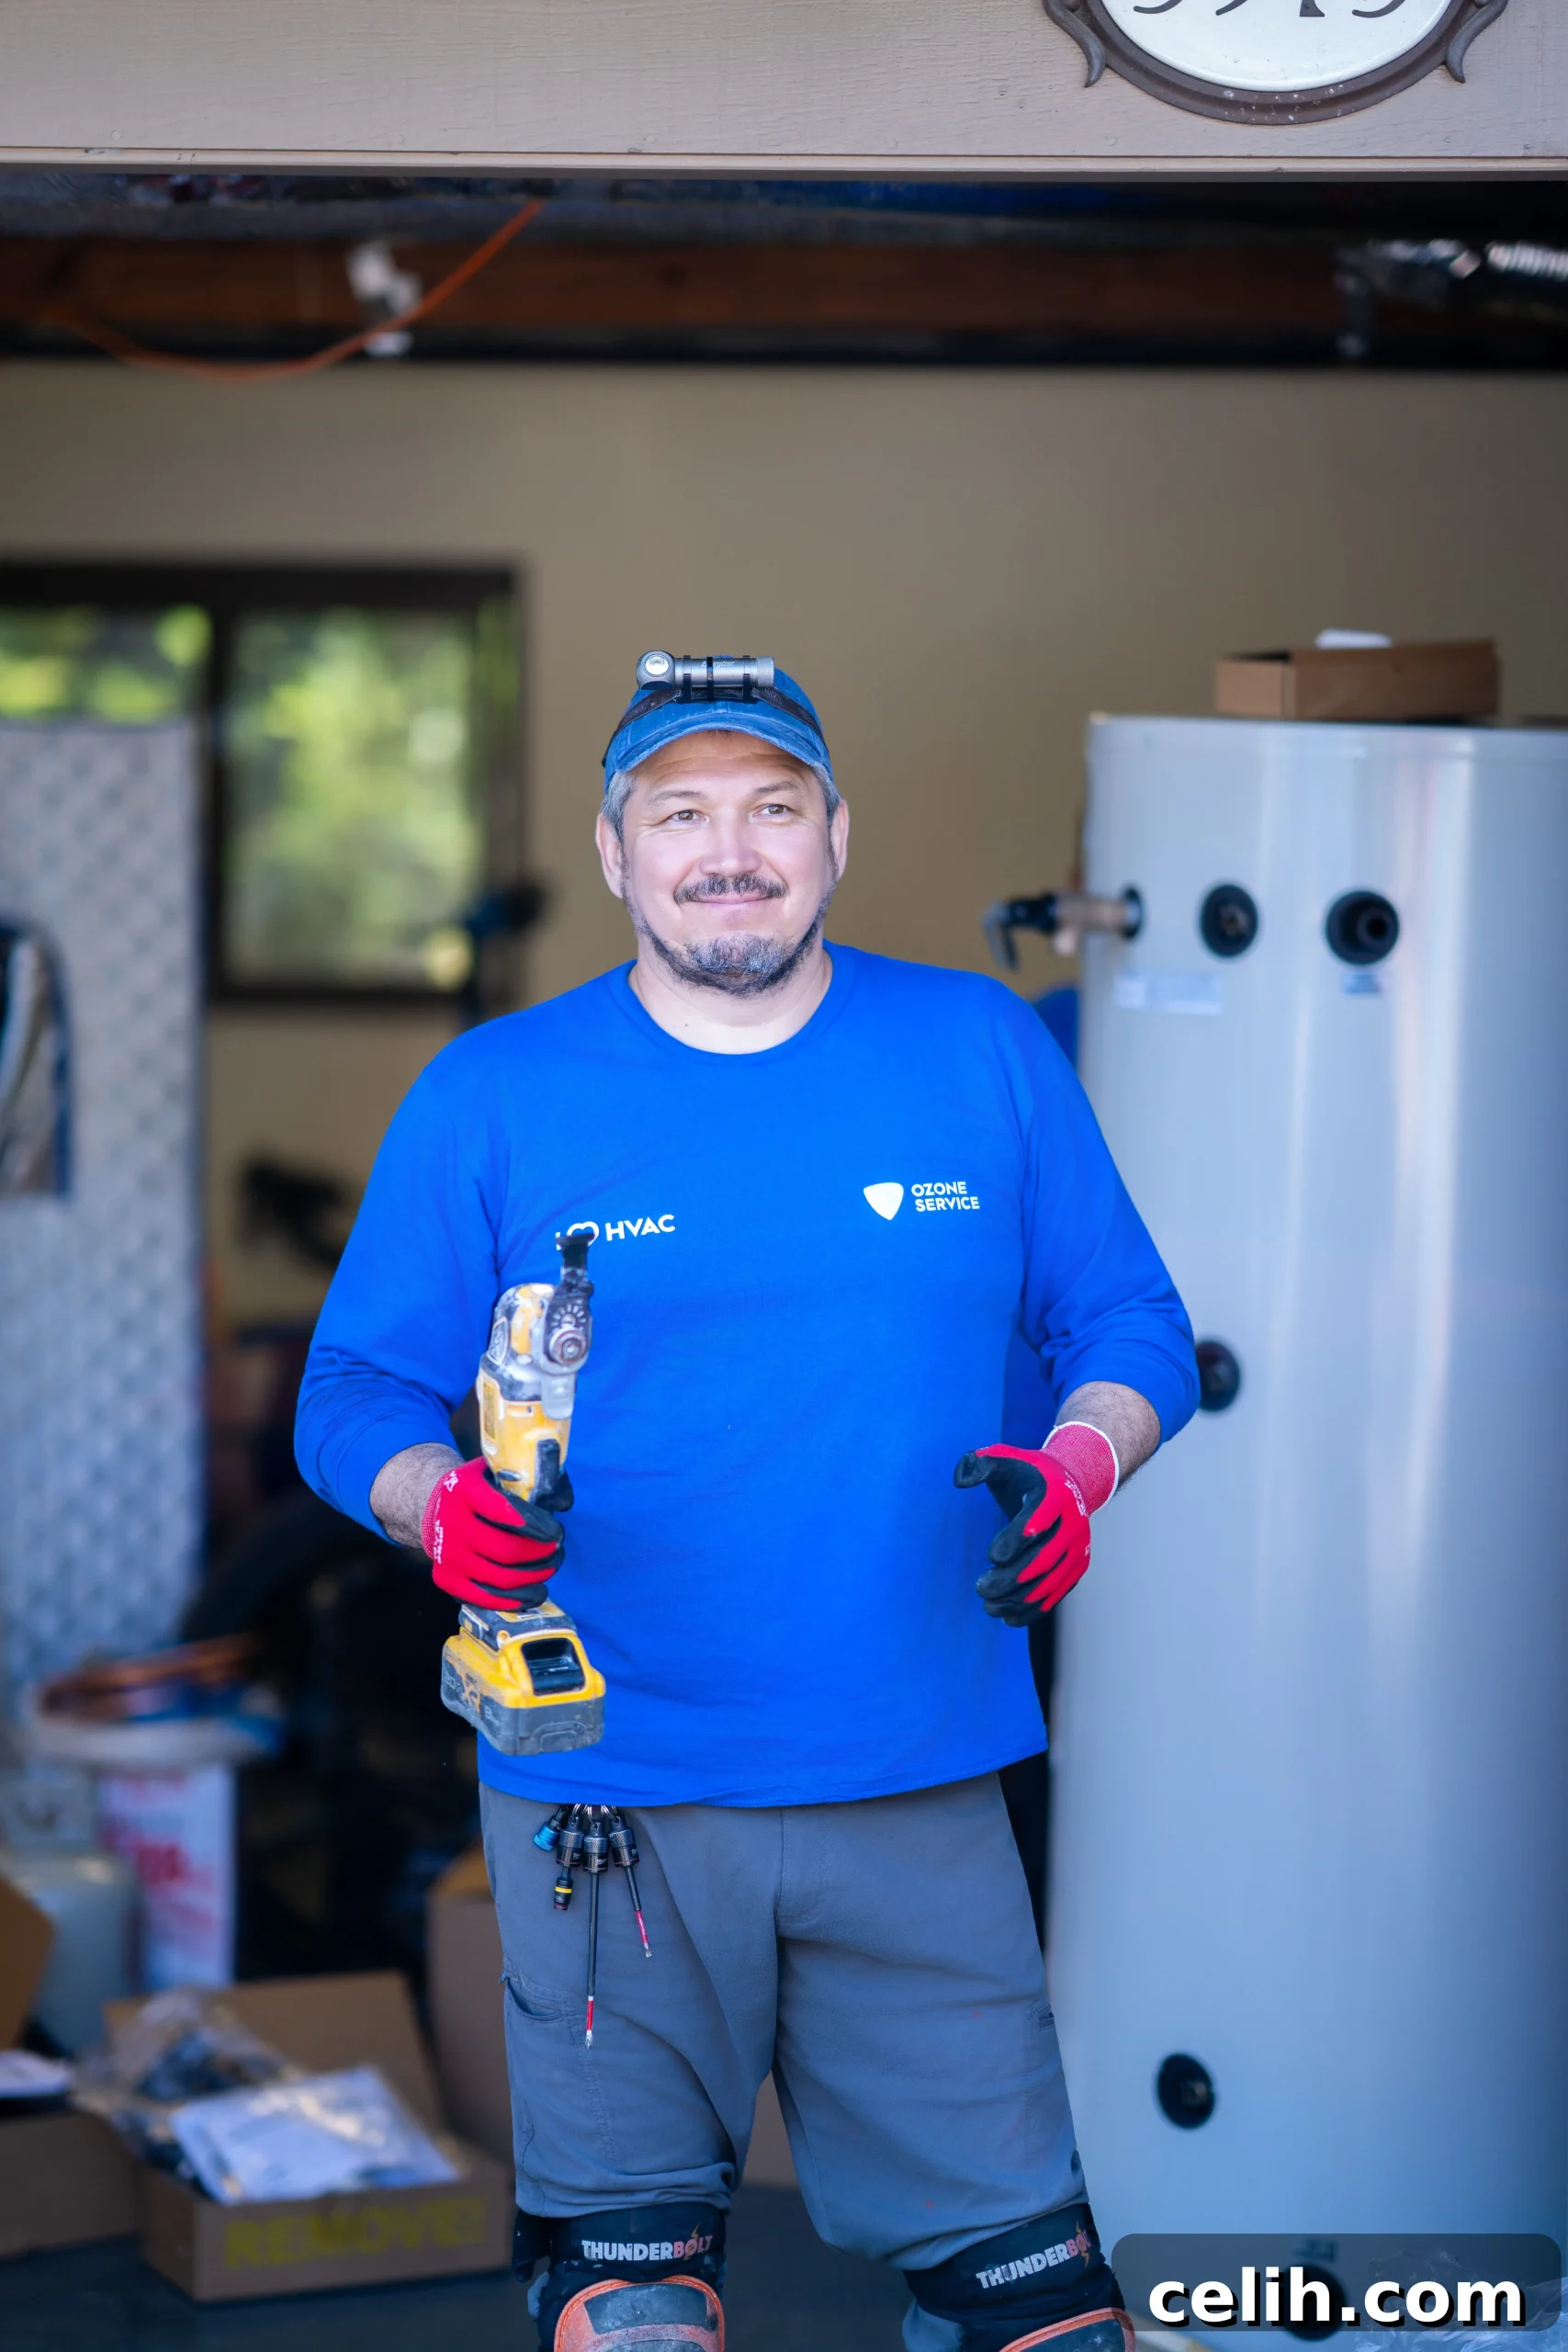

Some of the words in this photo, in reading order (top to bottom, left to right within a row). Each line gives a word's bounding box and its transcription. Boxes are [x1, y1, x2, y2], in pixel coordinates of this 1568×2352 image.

[911, 1182, 968, 1197] OZONE
[915, 1196, 980, 1212] SERVICE
[605, 1214, 676, 1241] HVAC
[581, 2235, 713, 2261] THUNDERBOLT
